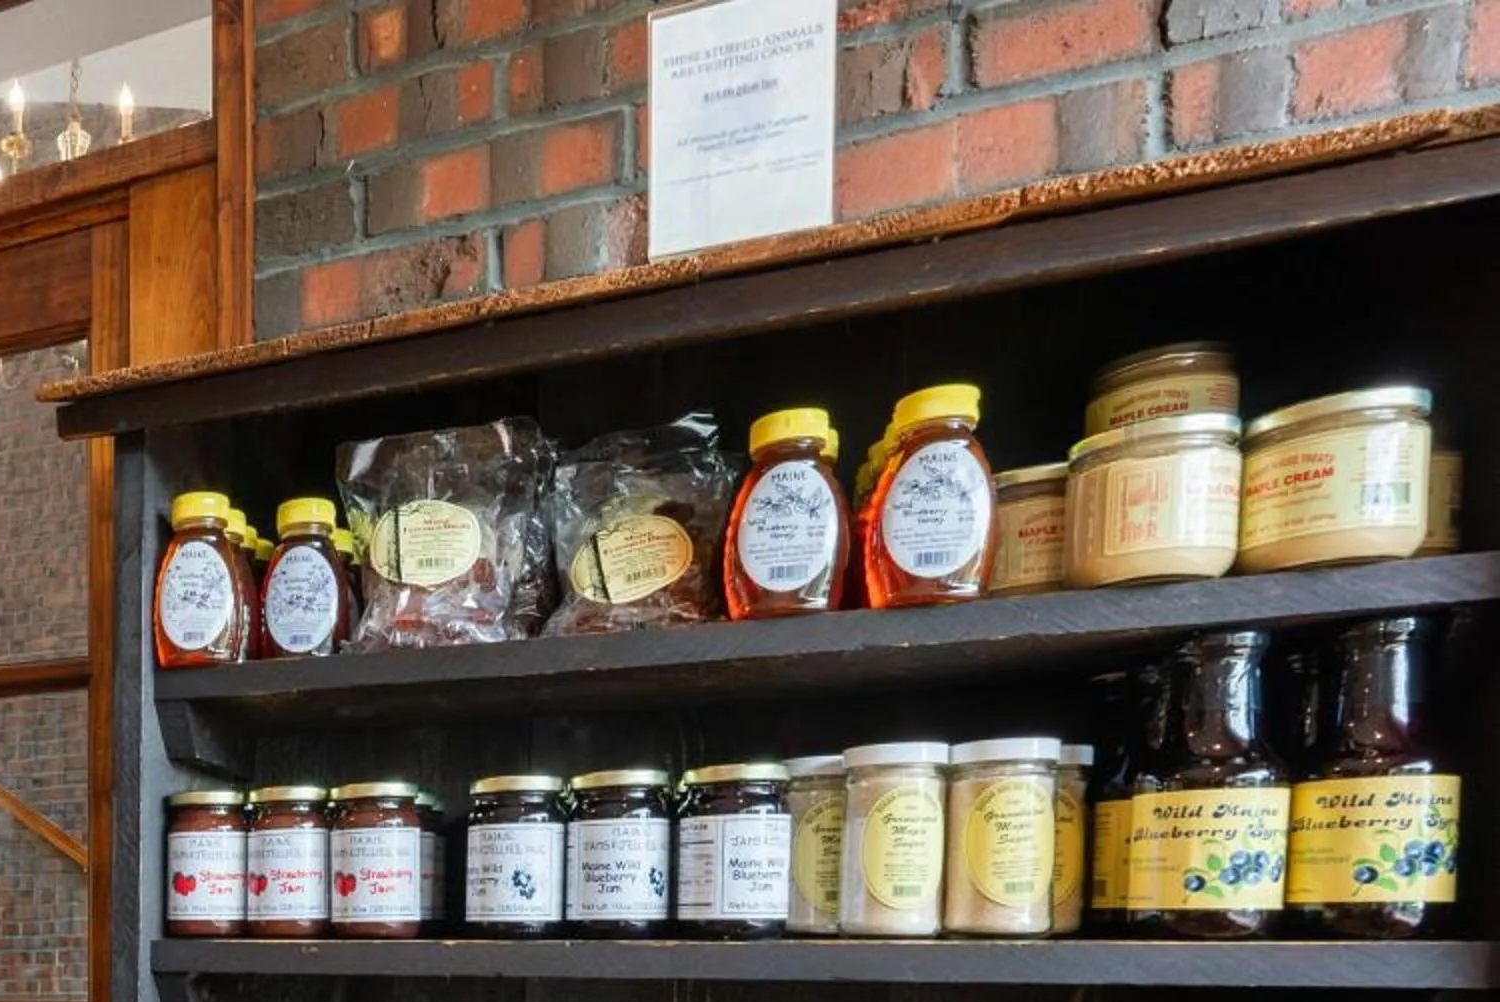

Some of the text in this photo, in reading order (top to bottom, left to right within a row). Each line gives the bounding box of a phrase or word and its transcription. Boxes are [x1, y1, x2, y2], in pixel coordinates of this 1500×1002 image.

[763, 22, 824, 47] ANIMALS
[761, 38, 815, 61] CANCER
[1148, 401, 1189, 416] CREAM
[1283, 466, 1335, 486] CREAM
[1316, 790, 1453, 809] Wild Maine
[1152, 803, 1280, 820] Wild Maine
[1290, 815, 1413, 833] Blueberry
[1133, 824, 1239, 843] Blueberry
[581, 860, 642, 871] Maine Wild
[268, 867, 324, 884] Strawberry
[358, 867, 413, 883] Strawberry
[583, 871, 636, 886] Blueberry
[278, 881, 305, 895] Jam
[369, 881, 395, 895] Jam
[597, 883, 622, 894] Jam
[747, 881, 773, 892] Jam
